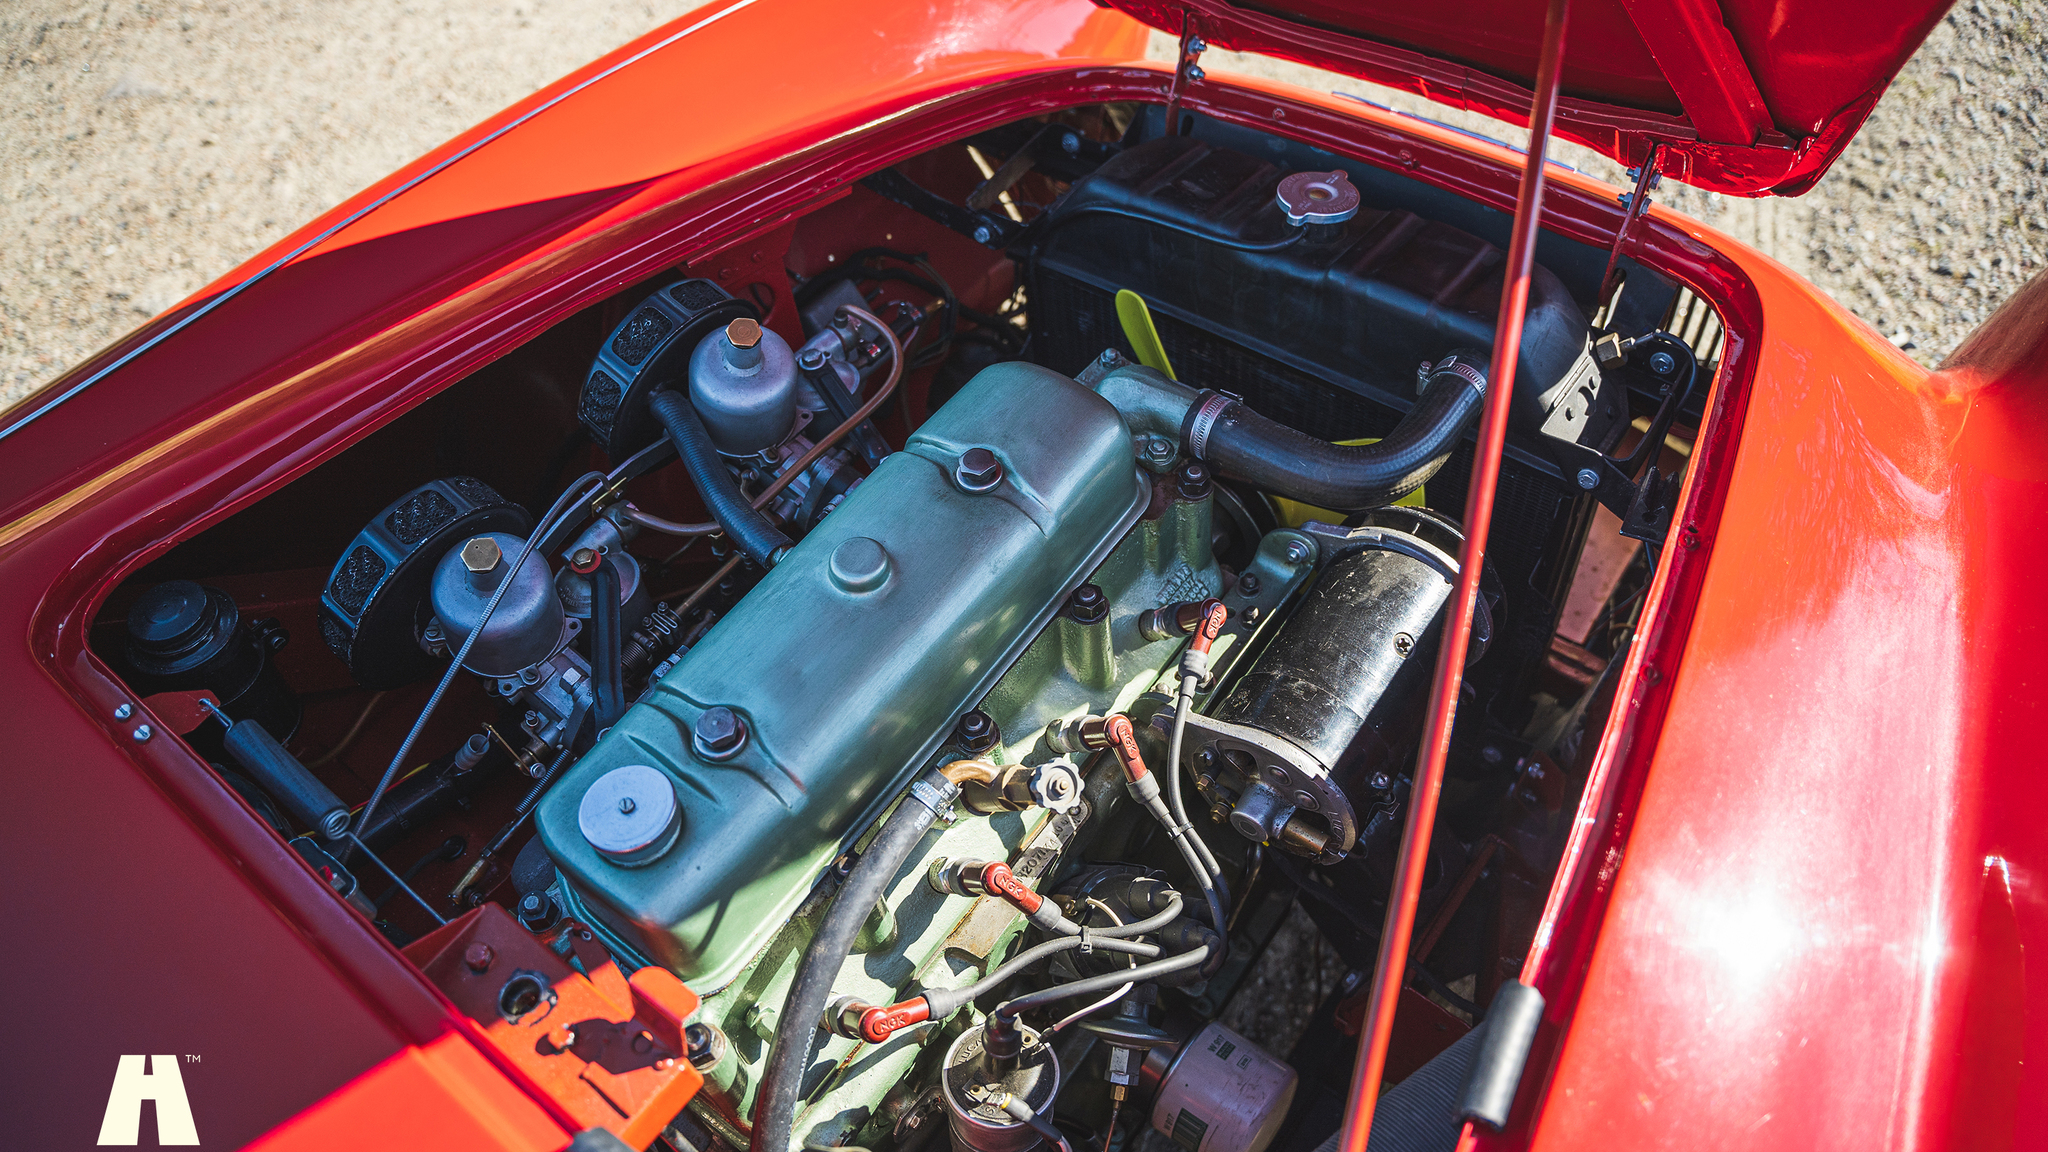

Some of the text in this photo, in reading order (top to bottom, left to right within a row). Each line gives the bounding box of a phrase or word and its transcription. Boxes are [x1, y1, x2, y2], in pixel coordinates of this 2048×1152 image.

[1209, 609, 1222, 635] NGK
[1121, 728, 1137, 755] NGK
[1327, 811, 1345, 848] LUCA
[1000, 875, 1023, 897] NGK
[880, 1013, 906, 1032] NGK
